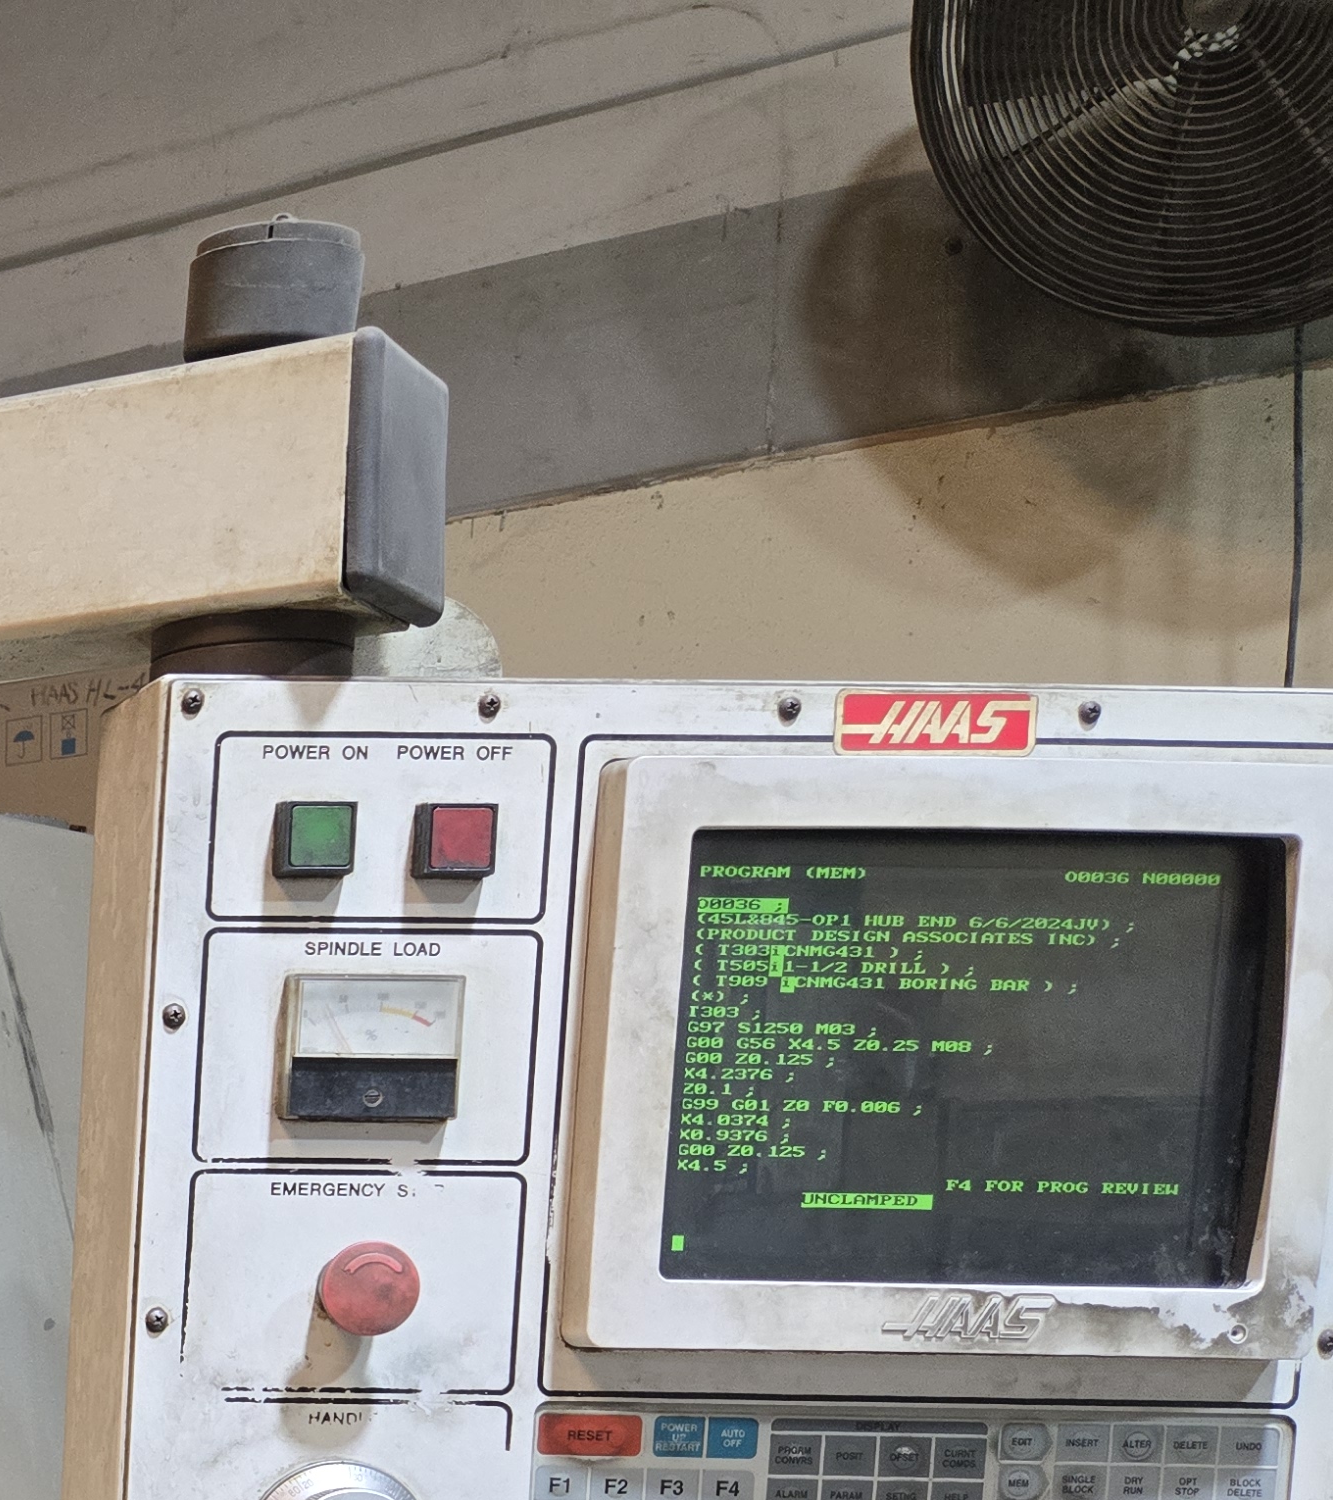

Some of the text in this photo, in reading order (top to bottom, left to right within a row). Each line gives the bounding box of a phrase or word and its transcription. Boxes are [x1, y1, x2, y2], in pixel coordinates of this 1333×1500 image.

[31, 682, 79, 706] HAAS
[842, 700, 1031, 744] HAAS
[263, 745, 368, 760] POWER ON
[397, 746, 513, 761] POWER OFF
[700, 866, 866, 879] PROGRAM (MEM)
[1142, 872, 1221, 886] N00000
[864, 915, 904, 927] HUB
[918, 915, 956, 929] END
[696, 928, 1096, 946] (PRODUCT DESIGN ASSOCIATES INC)
[305, 941, 441, 957] SPINDLE LOAD
[861, 962, 926, 974] DRILL
[898, 977, 977, 991] BORING
[990, 980, 1030, 992] BAR
[688, 1022, 856, 1035] G97 S1250 M03
[686, 1037, 972, 1053] G00 G56 X4.5 Z0.25 M08
[685, 1053, 813, 1066] G00 Z0.125
[684, 1068, 773, 1080] X4.2376
[683, 1083, 731, 1095] Z0.1
[682, 1098, 901, 1113] G99 G01 Z0 F0.006
[680, 1114, 768, 1127] X4.0374
[679, 1129, 768, 1142] X0.9376
[678, 1144, 806, 1158] G00 Z0.125
[677, 1160, 727, 1172] X4.5
[271, 1182, 385, 1197] EMERGENCY
[945, 1179, 1179, 1195] F4 FOR PROG REVIEW
[802, 1193, 918, 1207] UNCLAMPED
[882, 1295, 1056, 1342] HAAS
[661, 1423, 698, 1433] POWER
[721, 1429, 745, 1438] AUTO
[567, 1429, 613, 1441] RESET
[1011, 1437, 1033, 1446] EDIT
[723, 1439, 742, 1448] OFF
[1065, 1438, 1098, 1447] INSERT
[1122, 1440, 1151, 1449] ALTER
[1173, 1440, 1207, 1450] DELETE
[1236, 1442, 1263, 1451] UNDO
[549, 1478, 571, 1493] F1
[604, 1479, 627, 1494] F2
[1008, 1479, 1029, 1488] MEM
[1062, 1476, 1096, 1484] SINGLE
[1125, 1476, 1143, 1485] DRY
[1179, 1477, 1197, 1486] OPT
[1230, 1478, 1261, 1487] BLOCK
[660, 1480, 683, 1495] F3
[716, 1481, 739, 1496] F4
[1062, 1485, 1093, 1494] BLOCK
[1123, 1486, 1143, 1494] RUN
[1175, 1487, 1200, 1496] STOP
[1227, 1488, 1262, 1497] DELETE
